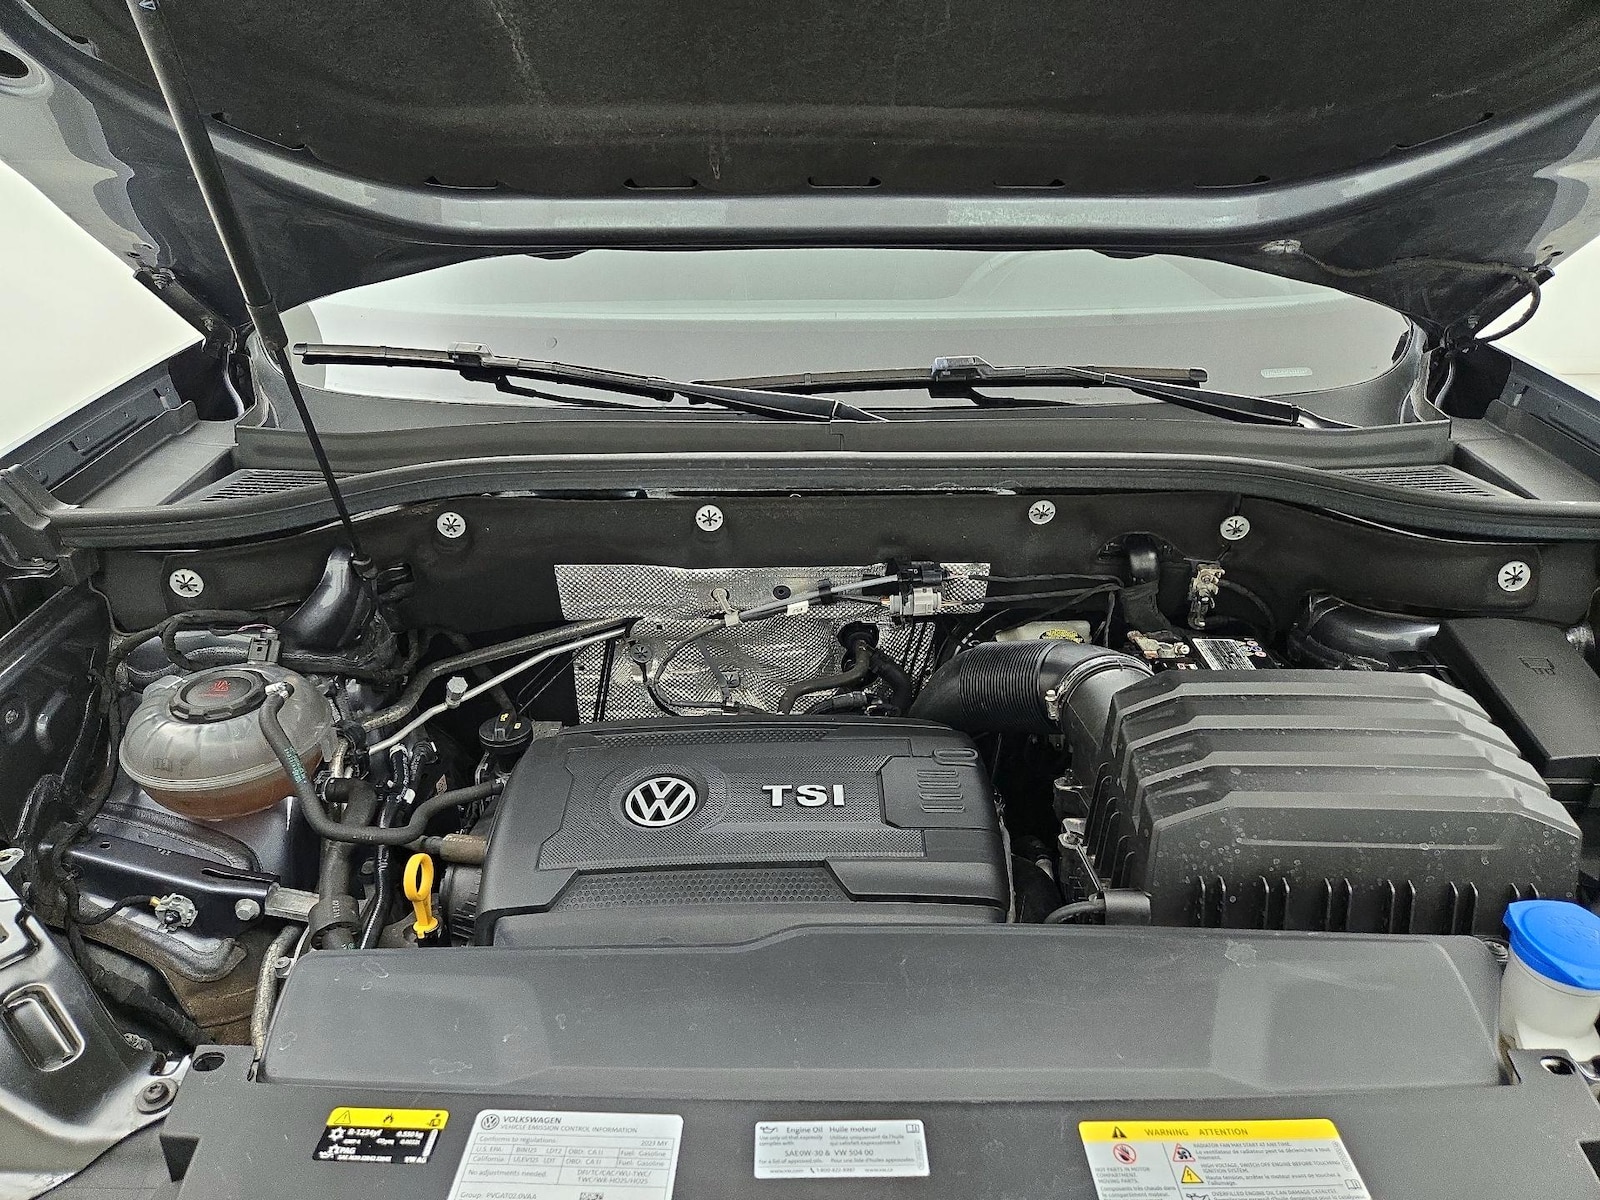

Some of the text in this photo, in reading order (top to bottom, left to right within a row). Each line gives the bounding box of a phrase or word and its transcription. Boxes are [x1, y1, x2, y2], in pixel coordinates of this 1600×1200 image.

[762, 784, 845, 807] TSI
[503, 1116, 562, 1124] VOLKSWAGEN
[786, 1127, 811, 1135] Engine
[1144, 1128, 1189, 1136] WARNING
[1199, 1128, 1249, 1136] ATTENTION
[520, 1137, 556, 1145] regulations
